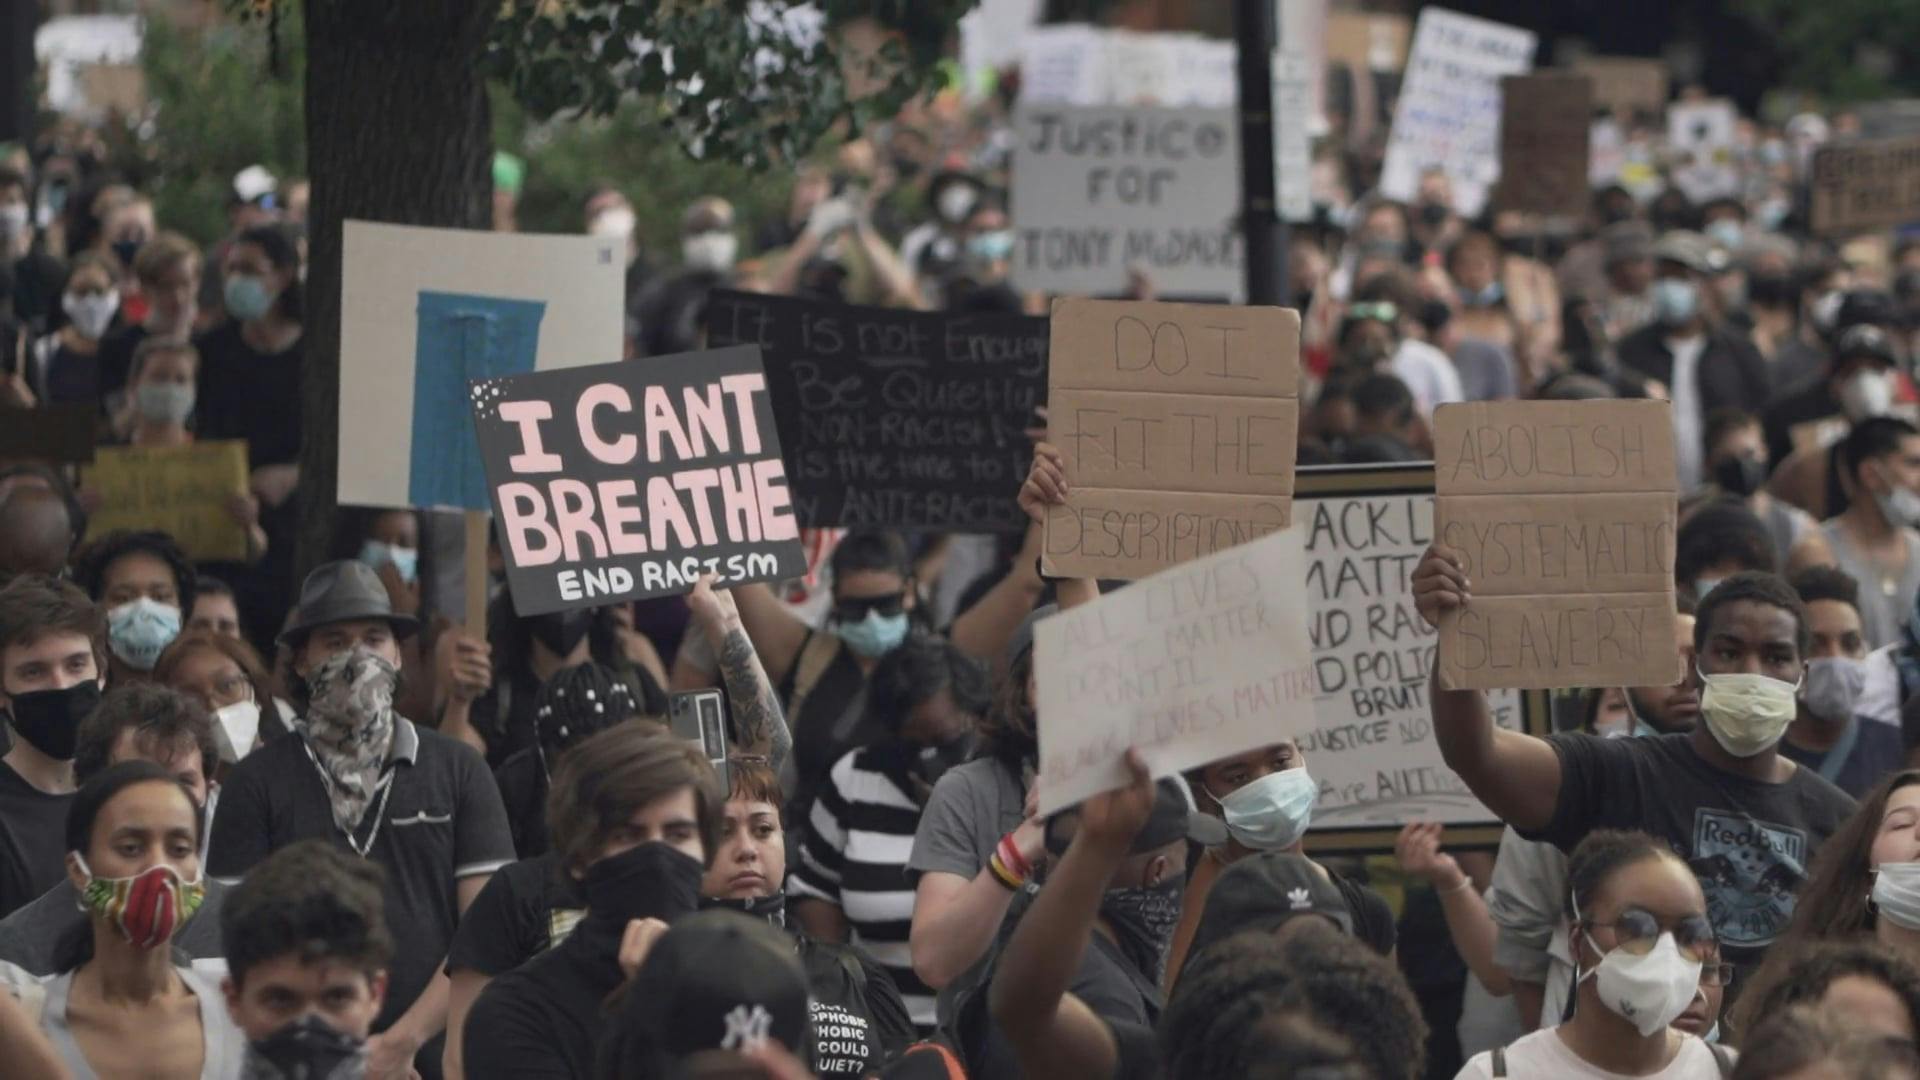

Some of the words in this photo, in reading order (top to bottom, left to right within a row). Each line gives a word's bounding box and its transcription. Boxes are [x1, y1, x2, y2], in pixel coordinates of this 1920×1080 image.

[801, 313, 844, 354] is
[857, 319, 930, 355] not
[945, 317, 1048, 376] Enoug
[1114, 315, 1190, 376] DO
[1203, 325, 1260, 381] I
[498, 400, 563, 473] I
[575, 373, 767, 464] CANT
[1064, 409, 1164, 473] FIT
[1171, 413, 1285, 476] THE
[1451, 424, 1649, 482] ABOLISH
[497, 458, 799, 567] BREATHE
[1304, 501, 1399, 551] ACK
[557, 567, 634, 600] END
[641, 553, 778, 590] RACISM
[1444, 521, 1674, 579] SYSTEMATIC
[1147, 557, 1261, 622] LIVES
[1166, 601, 1272, 656] MATTER
[1454, 607, 1647, 670] SLAVERY
[1353, 646, 1438, 687] POLIC
[1351, 682, 1425, 718] BRUT
[818, 1025, 865, 1040] HOBIC
[818, 1041, 869, 1057] COULD
[819, 1057, 864, 1074] UIET?
